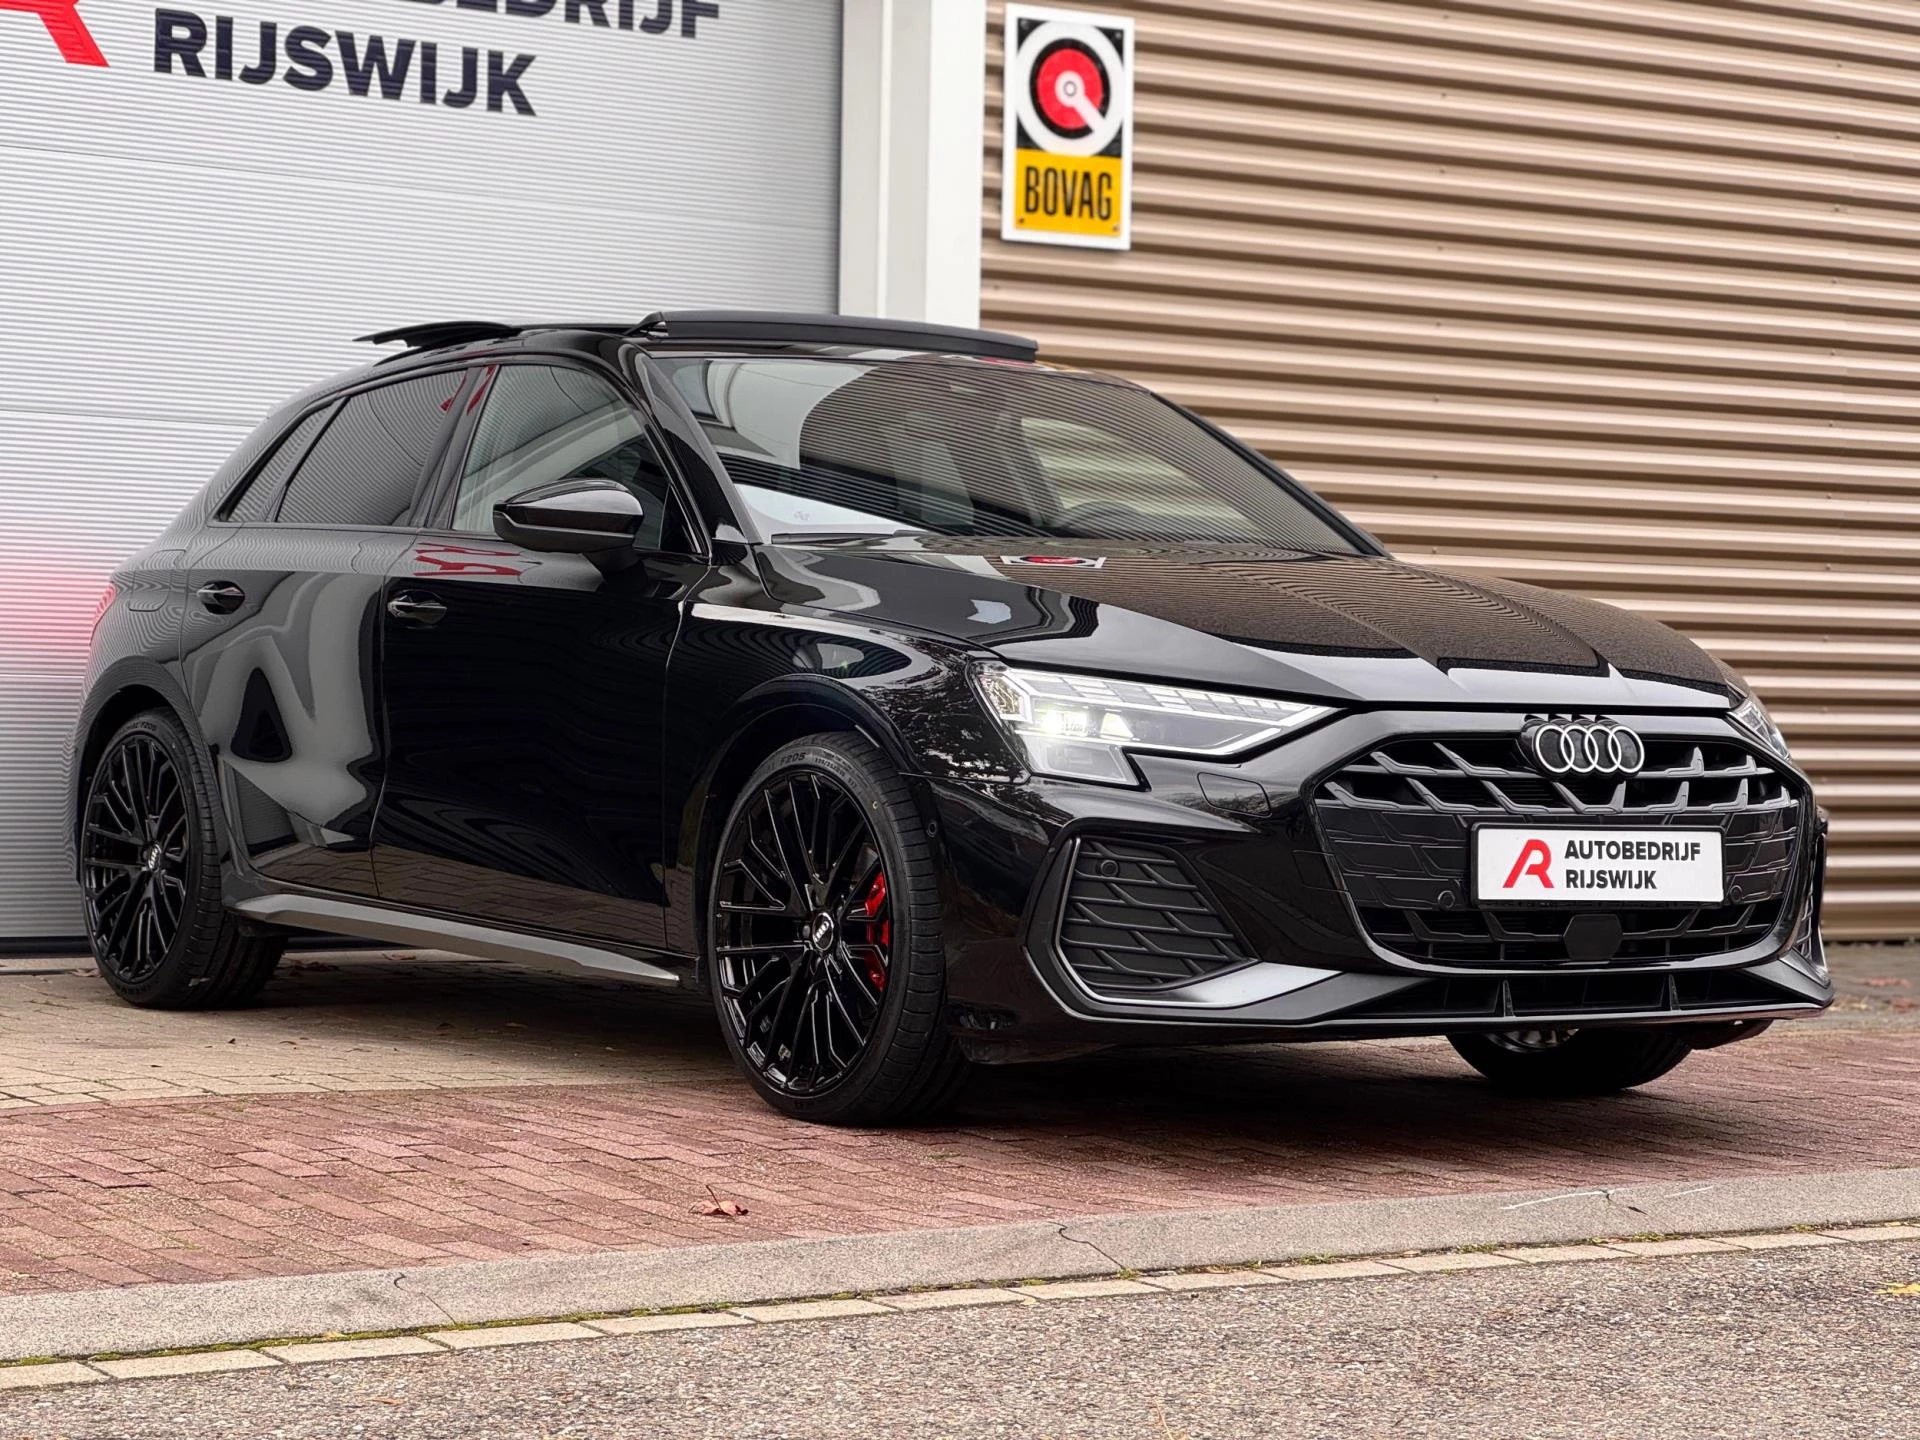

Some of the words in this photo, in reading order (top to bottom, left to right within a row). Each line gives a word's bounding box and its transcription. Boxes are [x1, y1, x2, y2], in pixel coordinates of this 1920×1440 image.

[154, 7, 537, 117] RIJSWIJK
[1024, 166, 1112, 221] BOVAG
[780, 752, 807, 766] F205
[1564, 840, 1701, 861] AUTOBEDRIJF
[1565, 869, 1658, 890] RIJSWIJK
